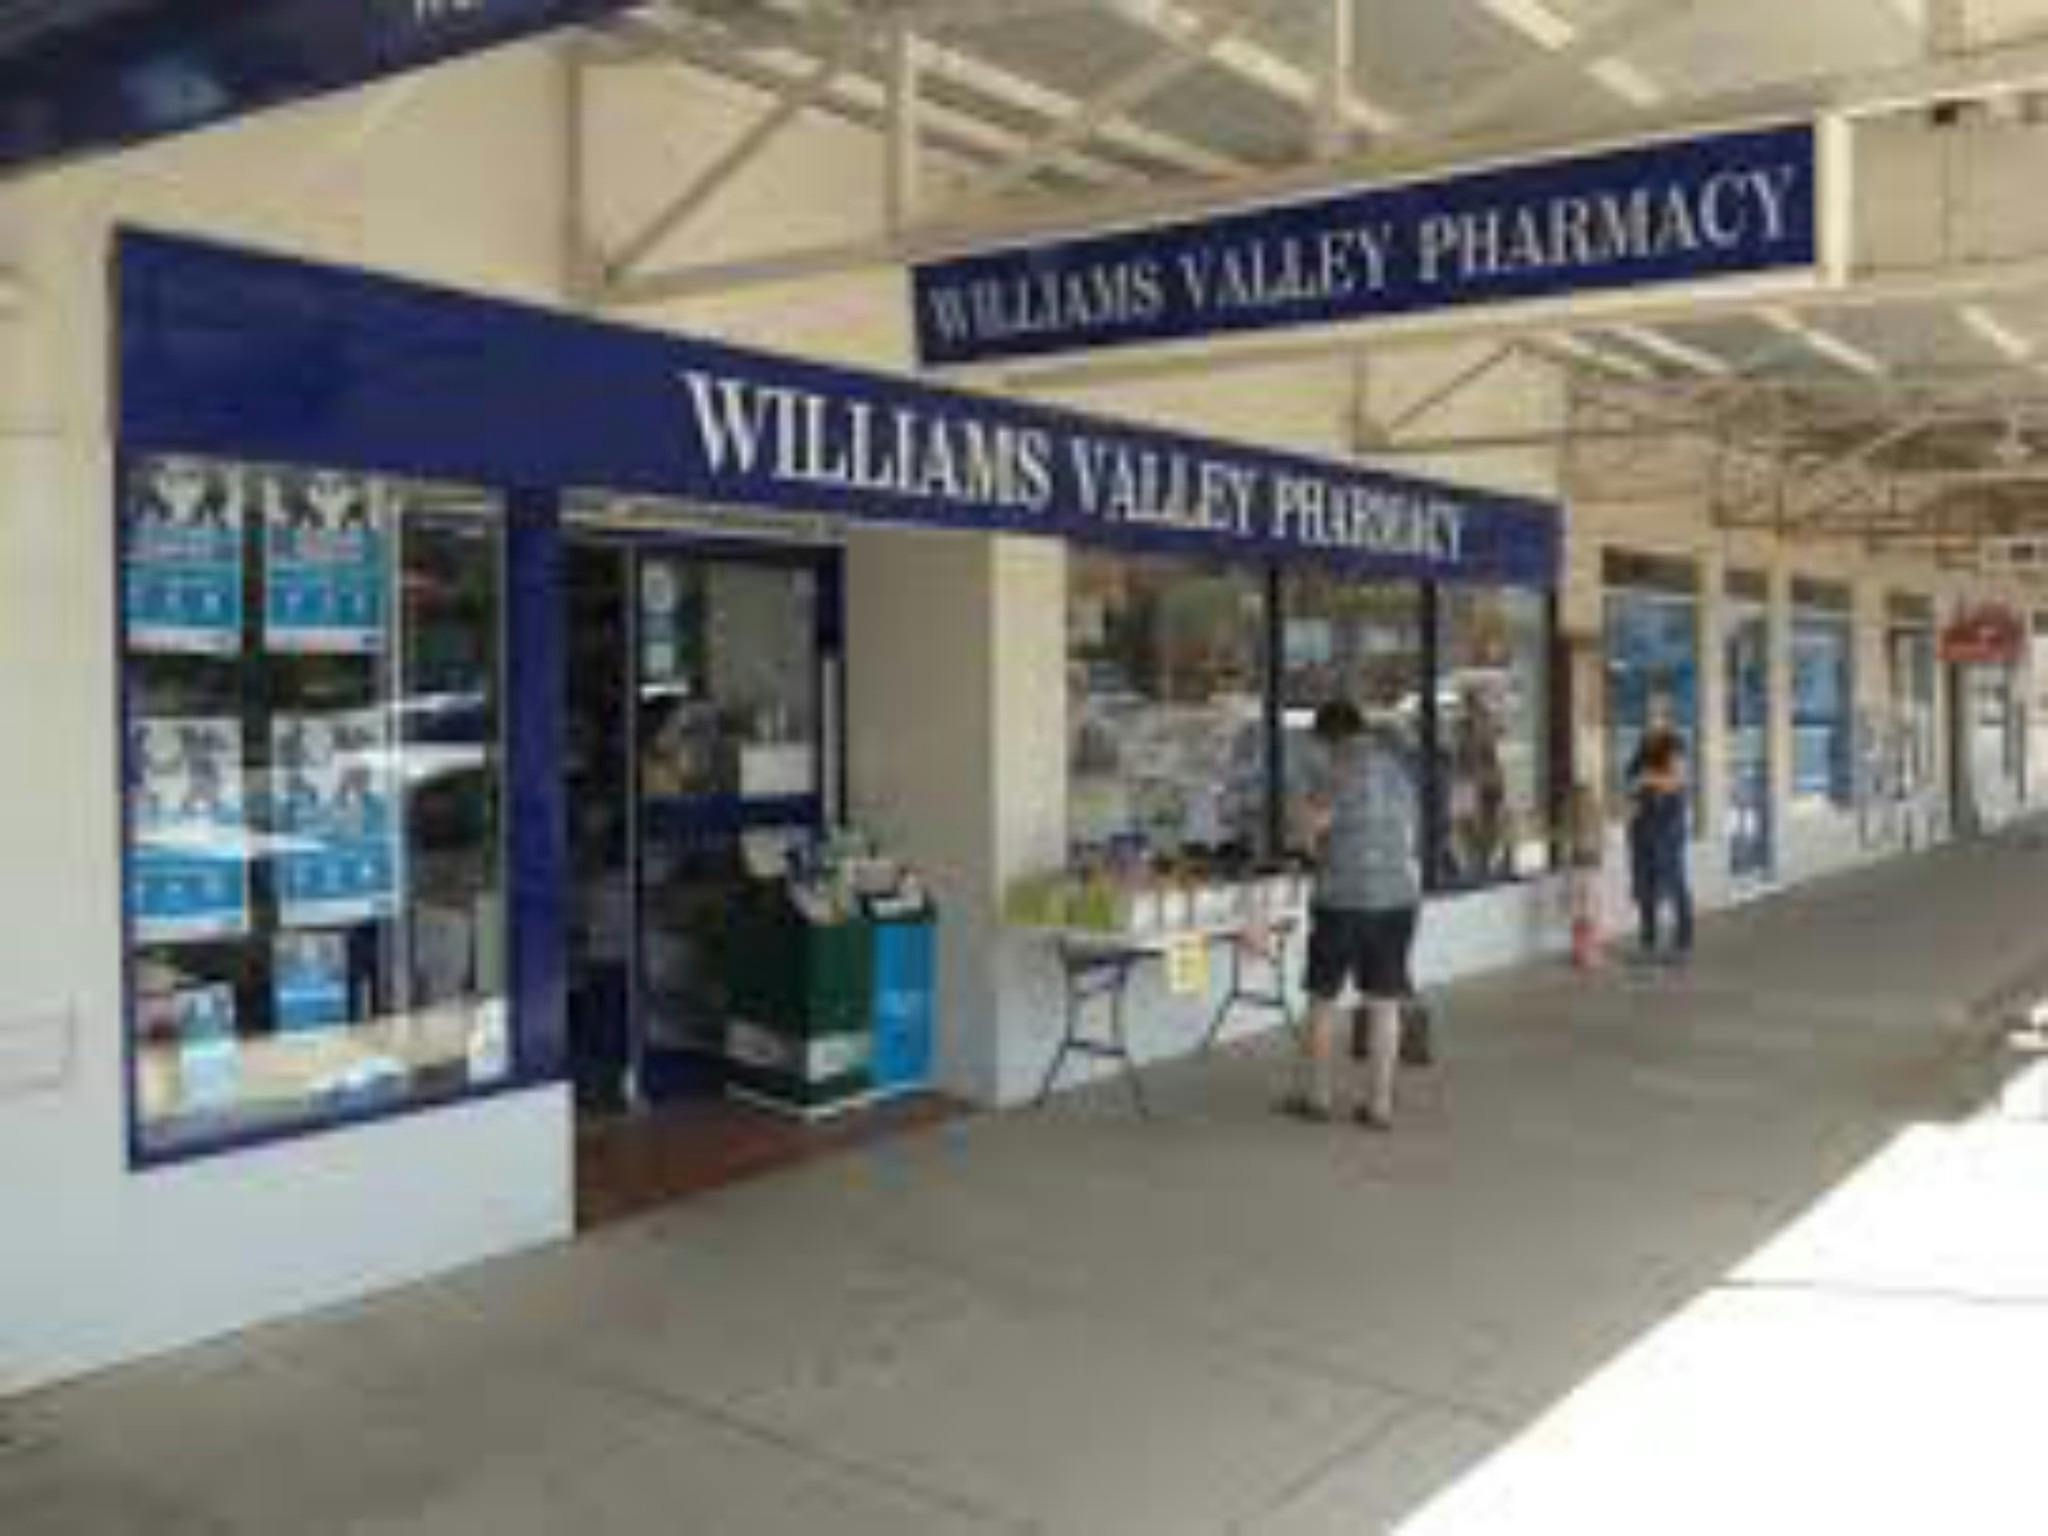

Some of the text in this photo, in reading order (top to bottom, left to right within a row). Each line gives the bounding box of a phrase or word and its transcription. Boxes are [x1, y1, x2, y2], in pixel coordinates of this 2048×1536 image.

[930, 166, 1796, 342] WILLIAMS VALLEY PHARMACY
[683, 371, 1462, 561] WILLIAMS VALLEY PHARMACY
